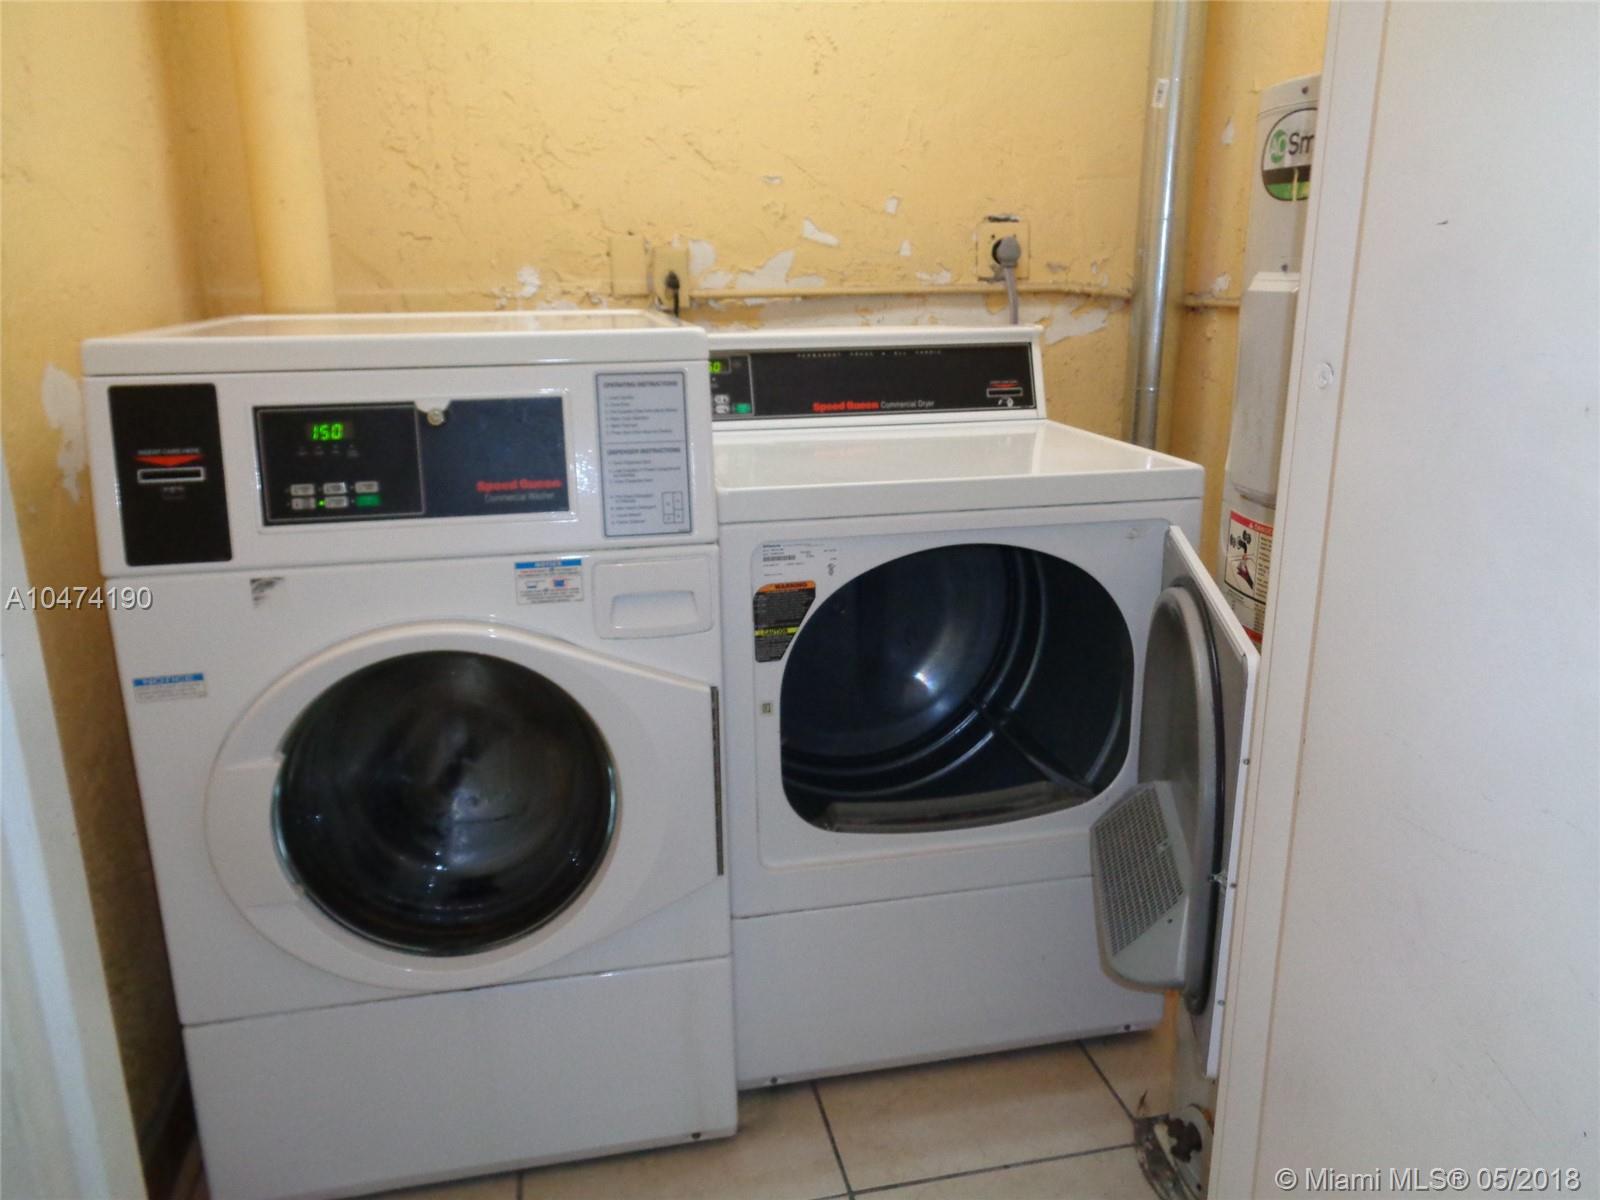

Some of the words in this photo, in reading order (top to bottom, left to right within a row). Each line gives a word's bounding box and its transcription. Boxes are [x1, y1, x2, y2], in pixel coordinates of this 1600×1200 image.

[812, 401, 845, 412] Speed
[846, 400, 880, 411] Queen
[880, 400, 917, 410] Commercial
[917, 399, 935, 409] Dryer
[476, 480, 519, 493] Speed
[520, 477, 563, 490] Queen
[484, 493, 527, 503] Commercial
[528, 491, 556, 501] Washer
